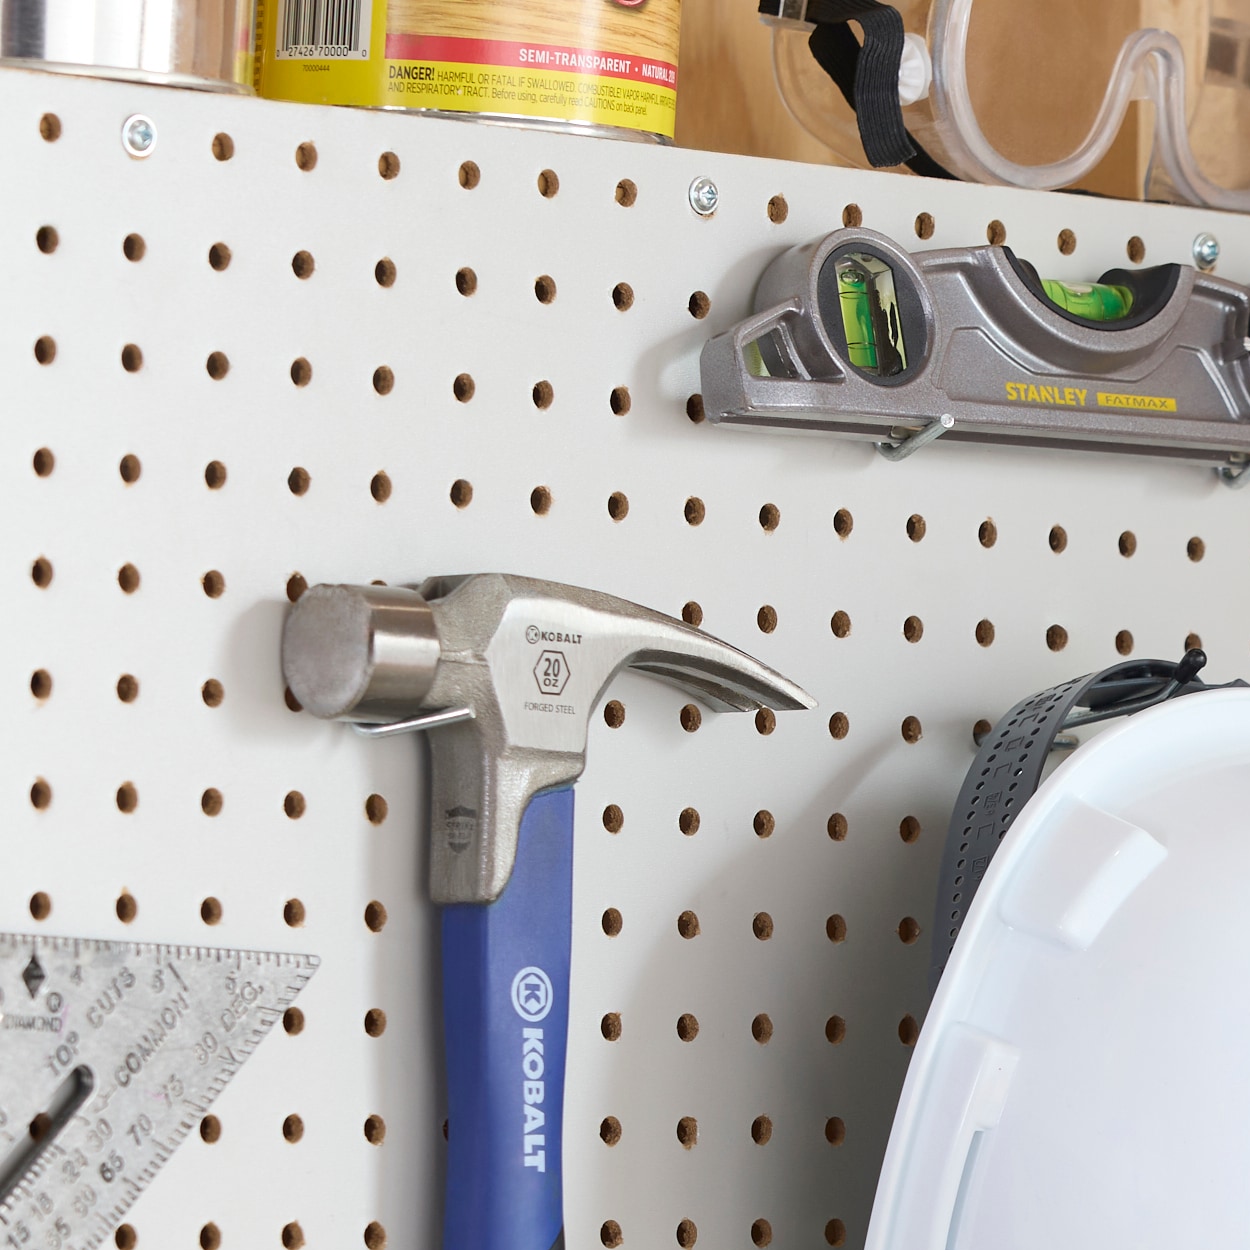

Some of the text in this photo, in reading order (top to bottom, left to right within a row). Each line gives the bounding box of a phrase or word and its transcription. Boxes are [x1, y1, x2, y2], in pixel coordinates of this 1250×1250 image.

[288, 46, 314, 57] 27426
[318, 46, 349, 57] 70000
[361, 49, 367, 58] 0
[519, 48, 631, 74] SEMI-TRANSPARENT
[641, 63, 669, 82] NATURAL
[388, 65, 435, 81] DANGER!
[437, 70, 475, 84] HARMFUL
[477, 73, 490, 85] OR
[491, 74, 516, 87] FATAL
[518, 76, 526, 88] IF
[527, 77, 576, 93] SWALLOWED.
[622, 88, 641, 101] VAPOR
[388, 81, 405, 93] AND
[406, 81, 460, 96] RESPIRATORY
[462, 85, 490, 98] TRACT.
[491, 87, 516, 100] Before
[517, 90, 538, 104] using,
[539, 92, 567, 107] carefully
[568, 96, 583, 107] read
[584, 96, 616, 112] CAUTIONS
[616, 103, 623, 111] on
[623, 102, 635, 114] back
[1005, 381, 1170, 410] STANLEY FATMAX
[541, 630, 582, 645] KOBALT
[543, 657, 561, 678] 20
[543, 677, 559, 688] OZ
[524, 701, 576, 715] FORGED STEEL
[47, 965, 137, 1077] TOP CUTS
[114, 991, 190, 1088] COMMON
[522, 1027, 546, 1173] KOBALT
[99, 1150, 125, 1184] 65
[127, 1113, 153, 1147] 70
[6, 1220, 32, 1250] 15
